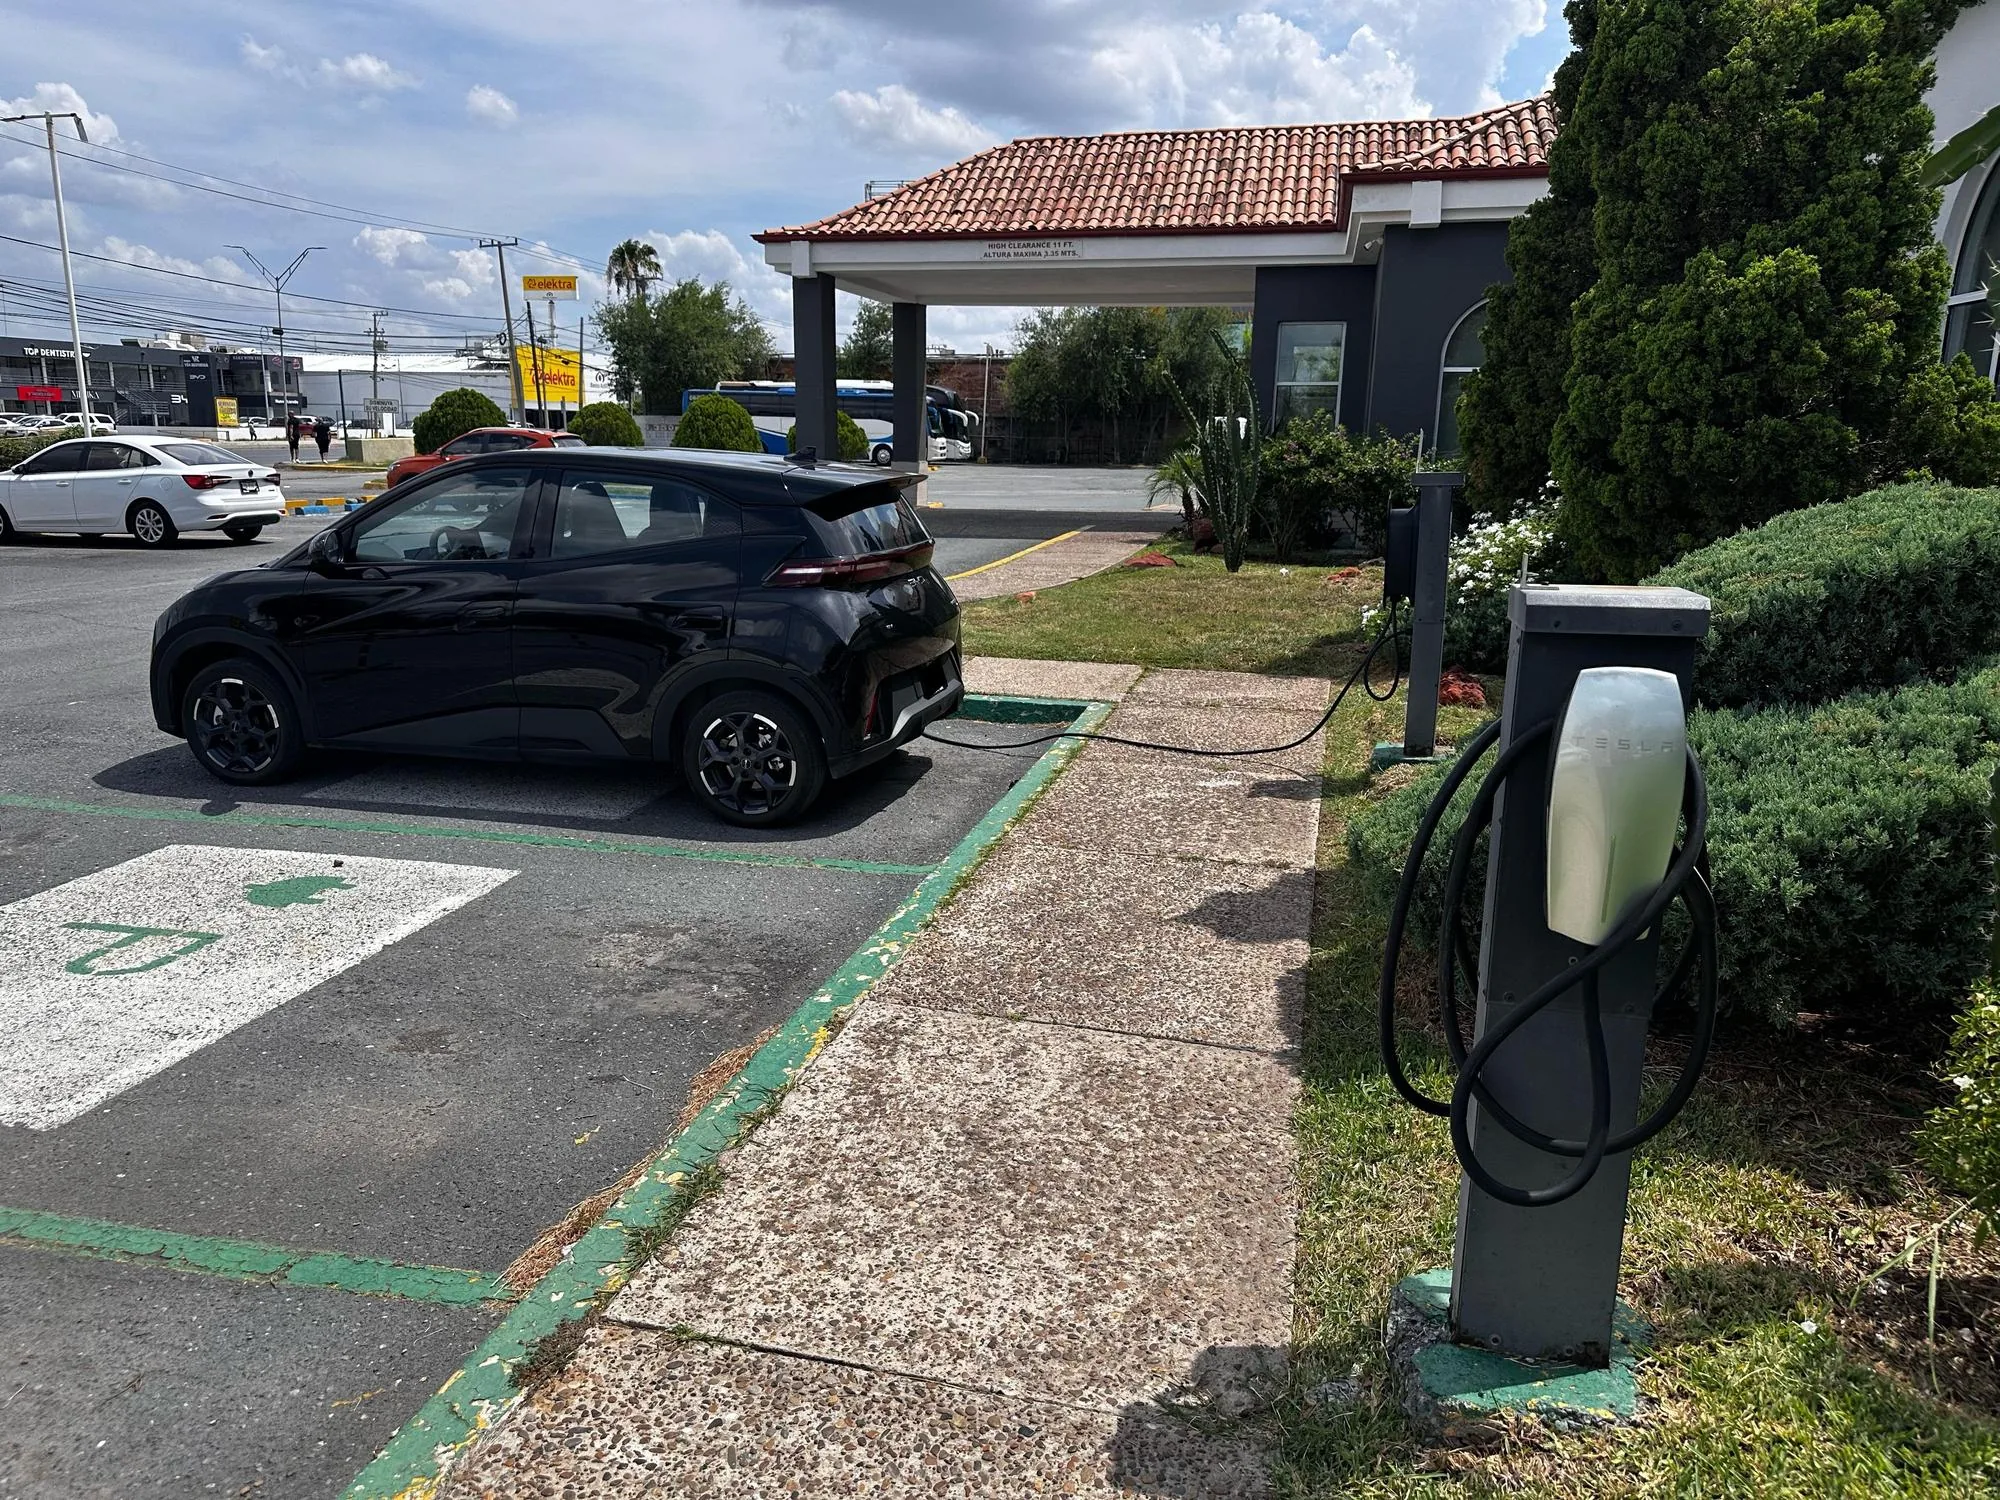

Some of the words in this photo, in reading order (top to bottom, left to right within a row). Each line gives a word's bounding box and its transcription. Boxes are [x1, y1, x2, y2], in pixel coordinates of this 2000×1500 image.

[537, 279, 572, 289] elektra
[24, 347, 39, 356] TOP
[40, 348, 76, 358] DENTISTR
[544, 369, 576, 386] elektra
[1571, 735, 1674, 752] TESLA
